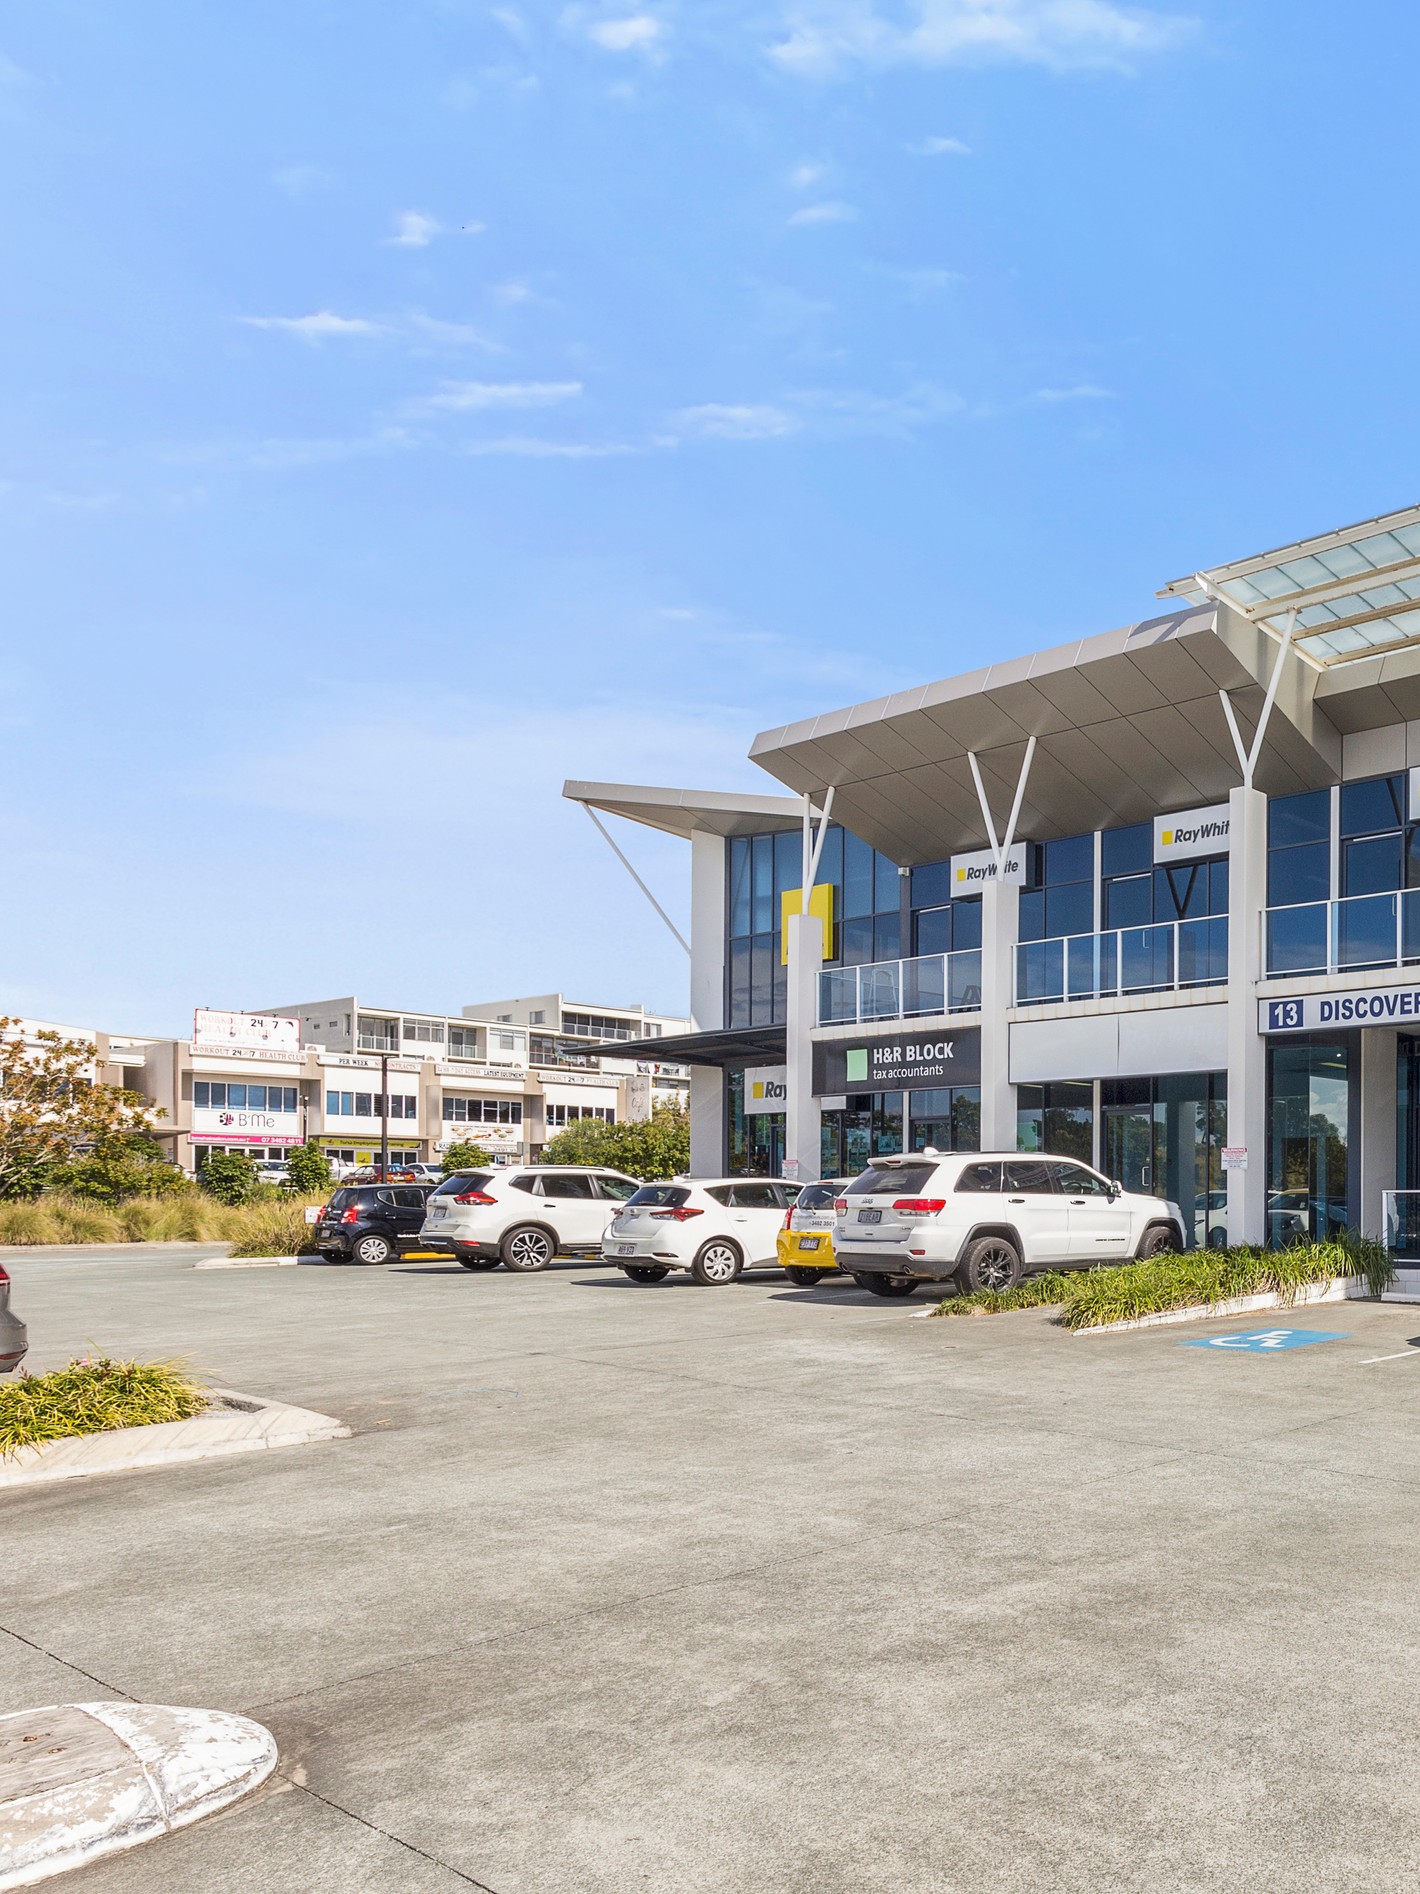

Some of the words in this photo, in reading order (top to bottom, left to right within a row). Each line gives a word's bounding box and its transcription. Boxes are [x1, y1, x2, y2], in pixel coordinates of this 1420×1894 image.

[1174, 820, 1230, 843] RayWhit
[967, 860, 1019, 881] RayWite
[1274, 1003, 1299, 1027] 13
[193, 1046, 229, 1055] WORKOUT
[259, 1051, 286, 1060] HEALTH
[288, 1053, 306, 1061] CLUB
[873, 1046, 902, 1064] H&R
[906, 1042, 954, 1062] BLOCK
[387, 1062, 416, 1070] ONTRACTS
[873, 1068, 887, 1080] tax
[888, 1064, 943, 1079] accountants
